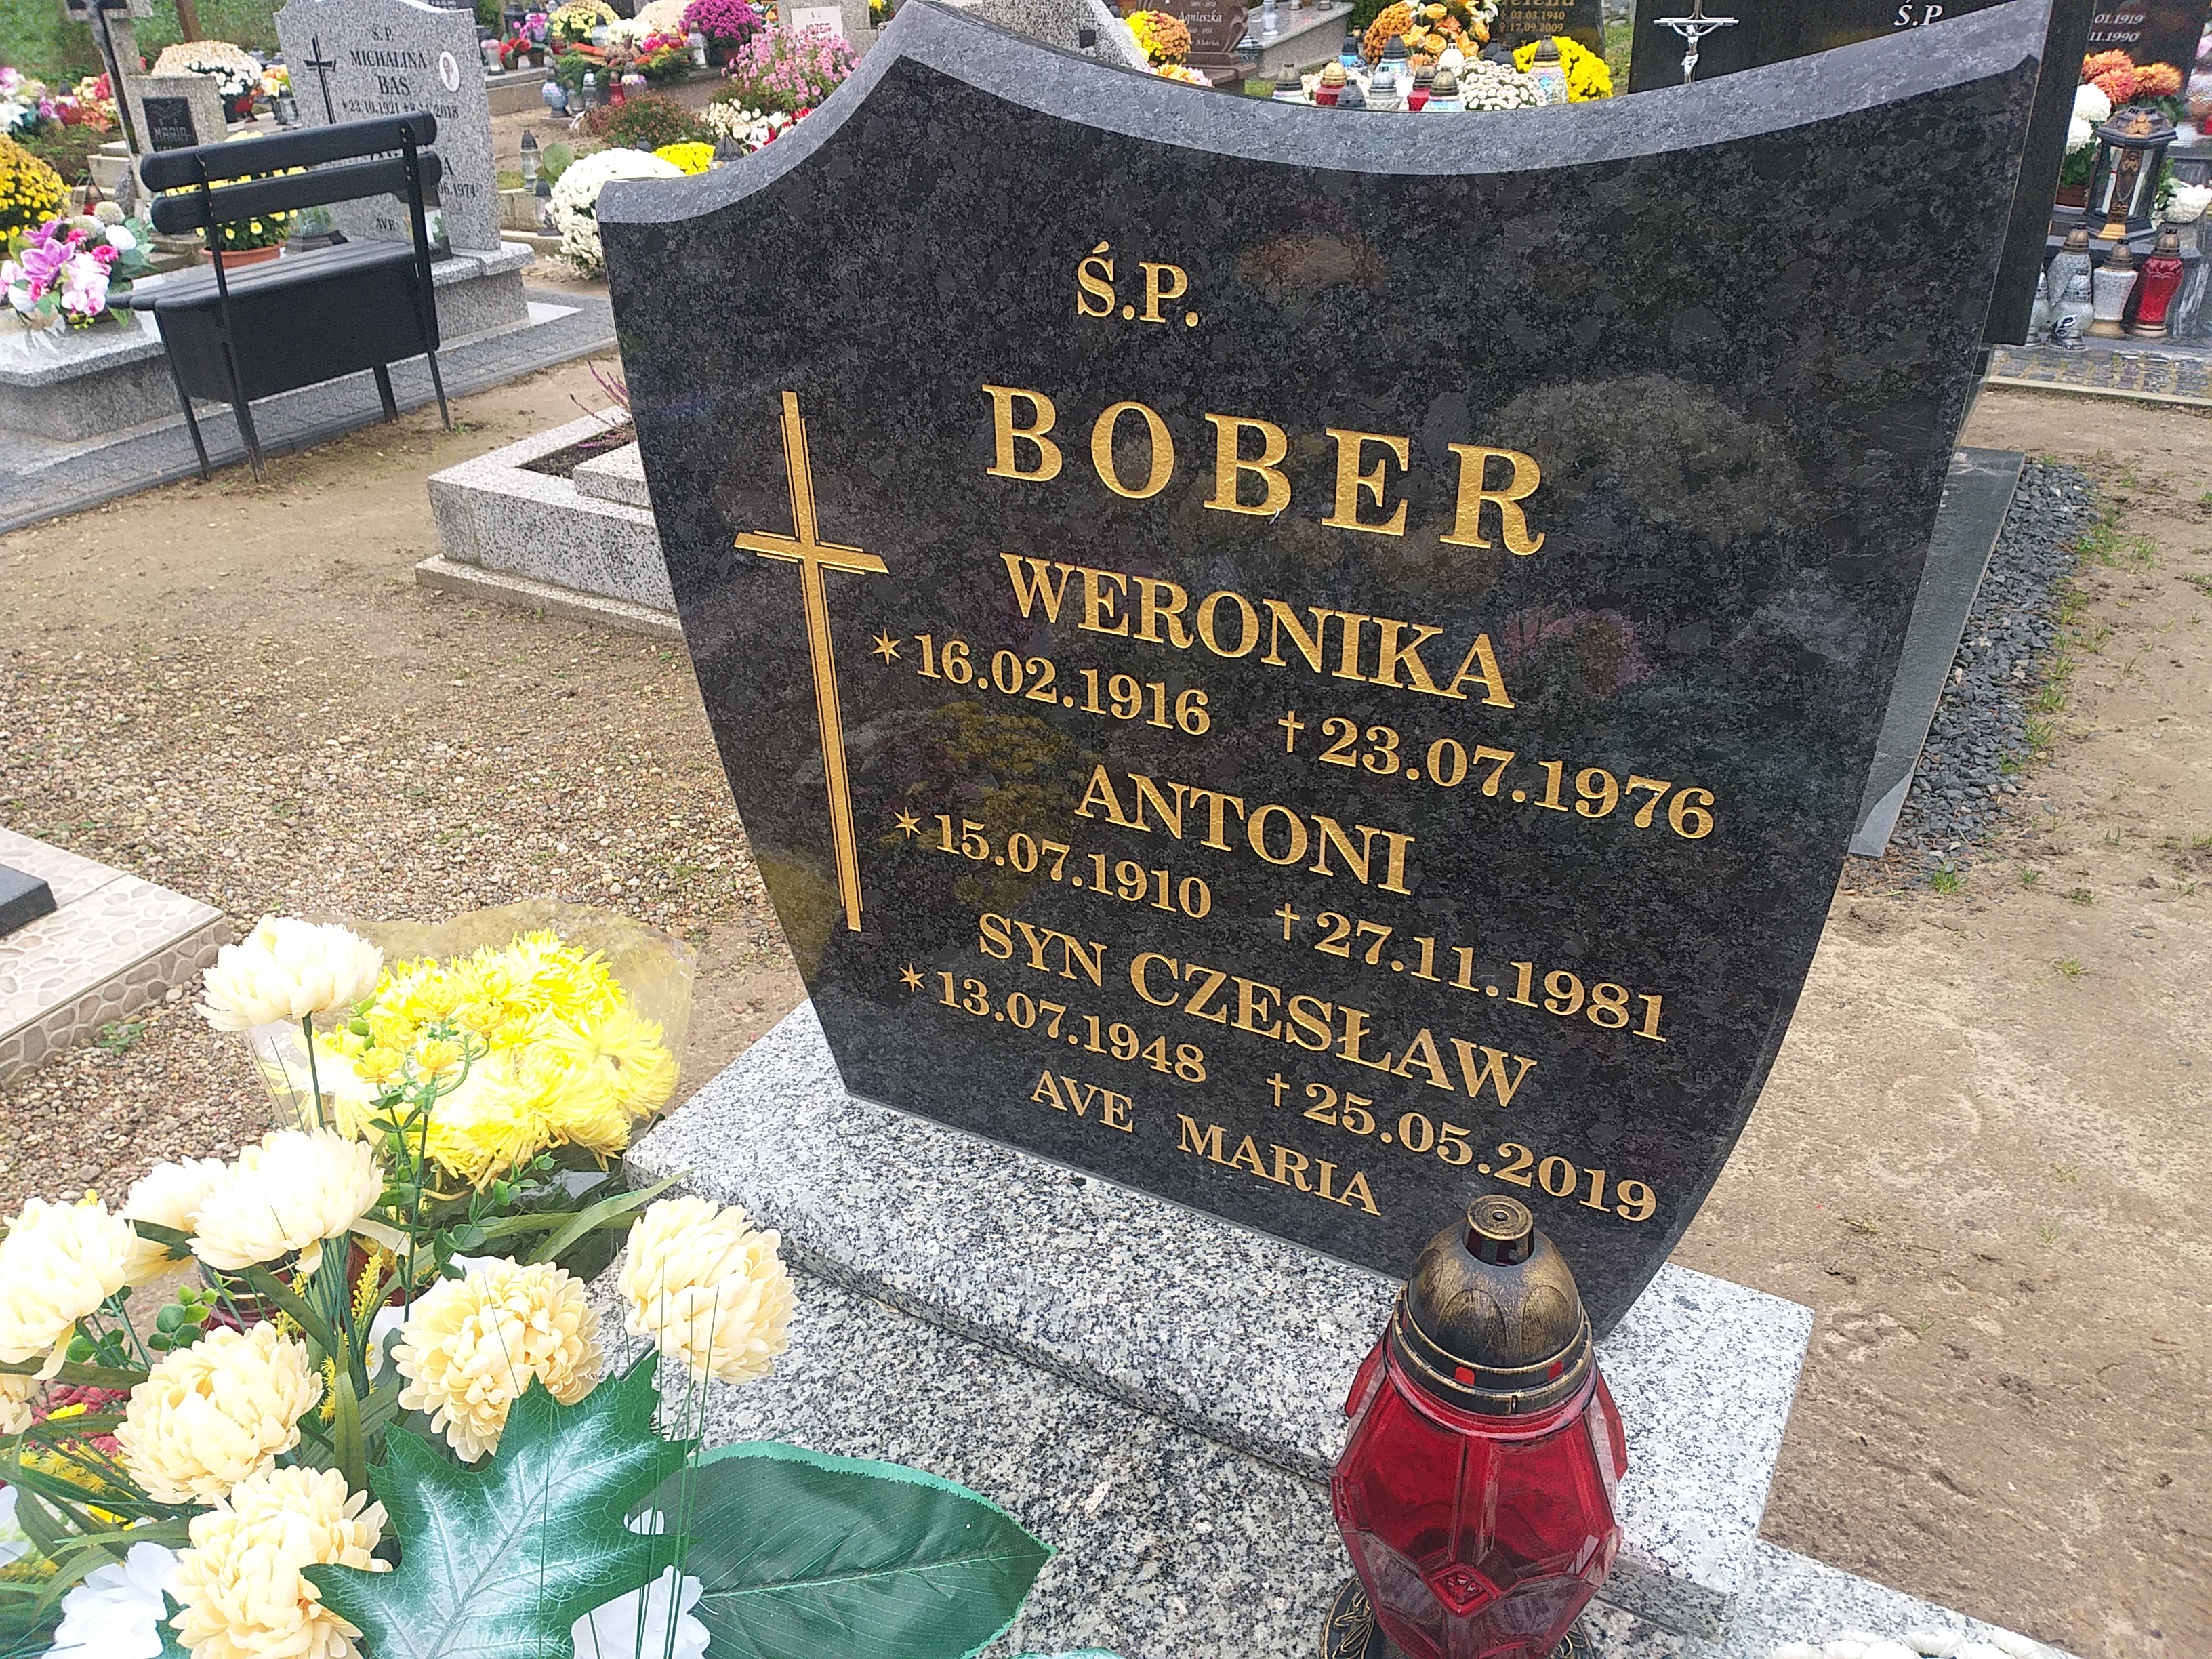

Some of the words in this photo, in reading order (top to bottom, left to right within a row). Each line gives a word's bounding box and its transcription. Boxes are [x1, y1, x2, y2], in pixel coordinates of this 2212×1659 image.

[349, 49, 427, 68] MICHALINA
[1077, 241, 1199, 327] Ś.P.
[981, 384, 1547, 556] BOBER
[1000, 552, 1515, 709] WERONIKA
[914, 634, 1210, 735] 16.02.1916
[1319, 717, 1715, 839] 23.07.1976
[1073, 764, 1416, 895] ANTONI
[934, 814, 1212, 918] 15.07.1910
[1314, 912, 1667, 1042] 27.11.1981
[979, 912, 1107, 987] SYN
[1130, 951, 1538, 1107] CZESŁAW
[937, 971, 1207, 1083] 13.07.1948
[1303, 1082, 1656, 1221] 25.05.2019
[1030, 1069, 1134, 1133] AVE
[1176, 1113, 1382, 1216] MARIA
